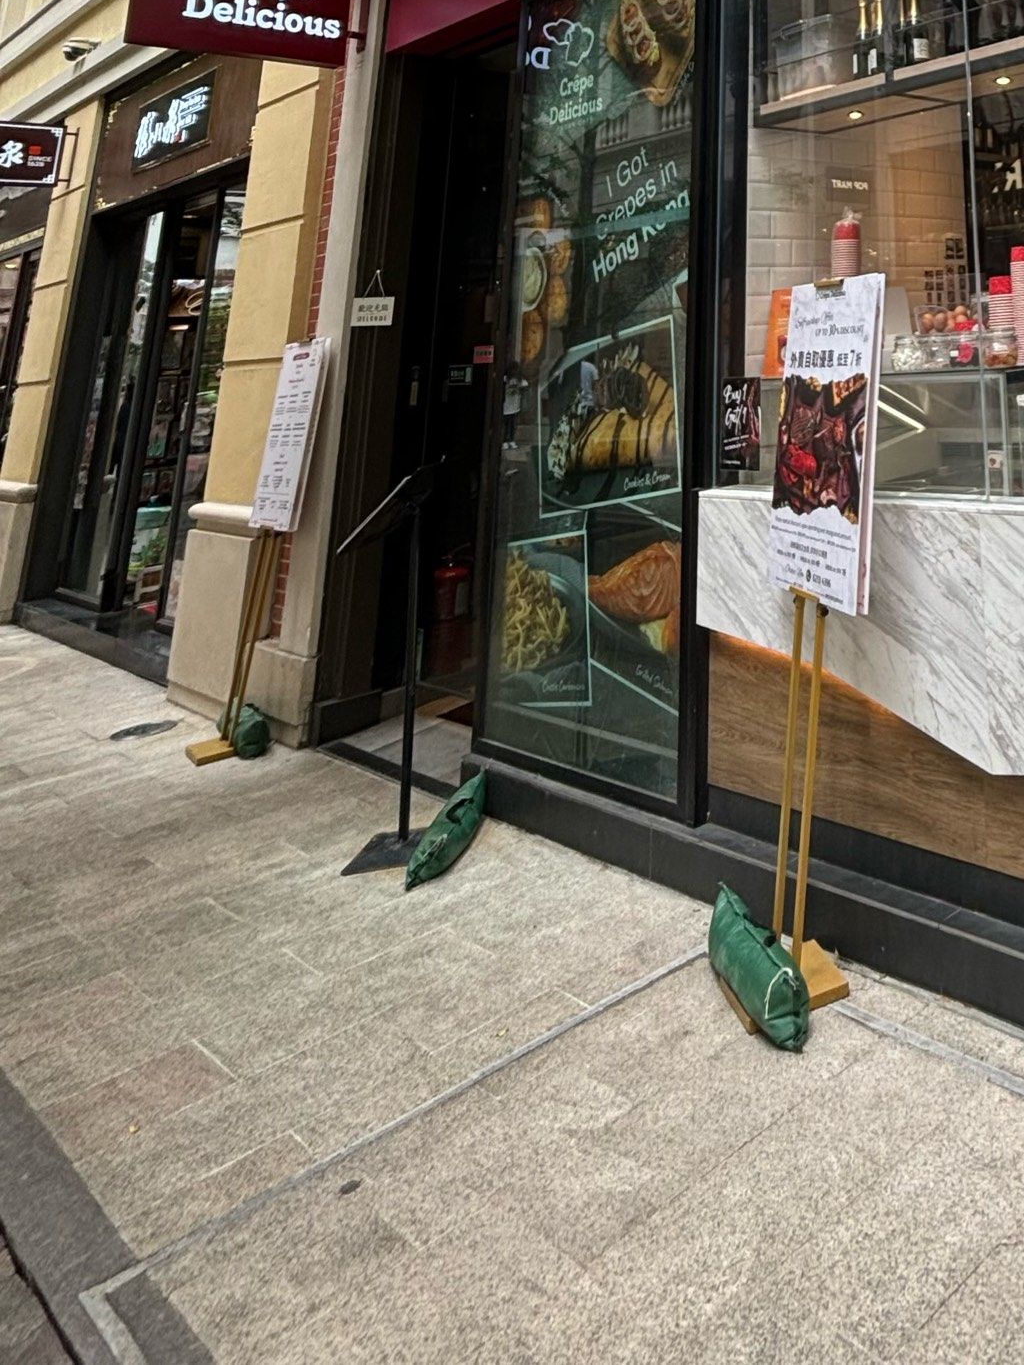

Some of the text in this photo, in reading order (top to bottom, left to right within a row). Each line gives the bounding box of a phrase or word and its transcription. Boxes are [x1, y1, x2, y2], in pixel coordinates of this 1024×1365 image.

[560, 75, 594, 97] Crêpe
[549, 98, 603, 125] Delicious
[606, 146, 649, 198] I Got
[659, 160, 677, 186] in
[592, 232, 639, 283] Hong
[723, 384, 742, 404] Buy
